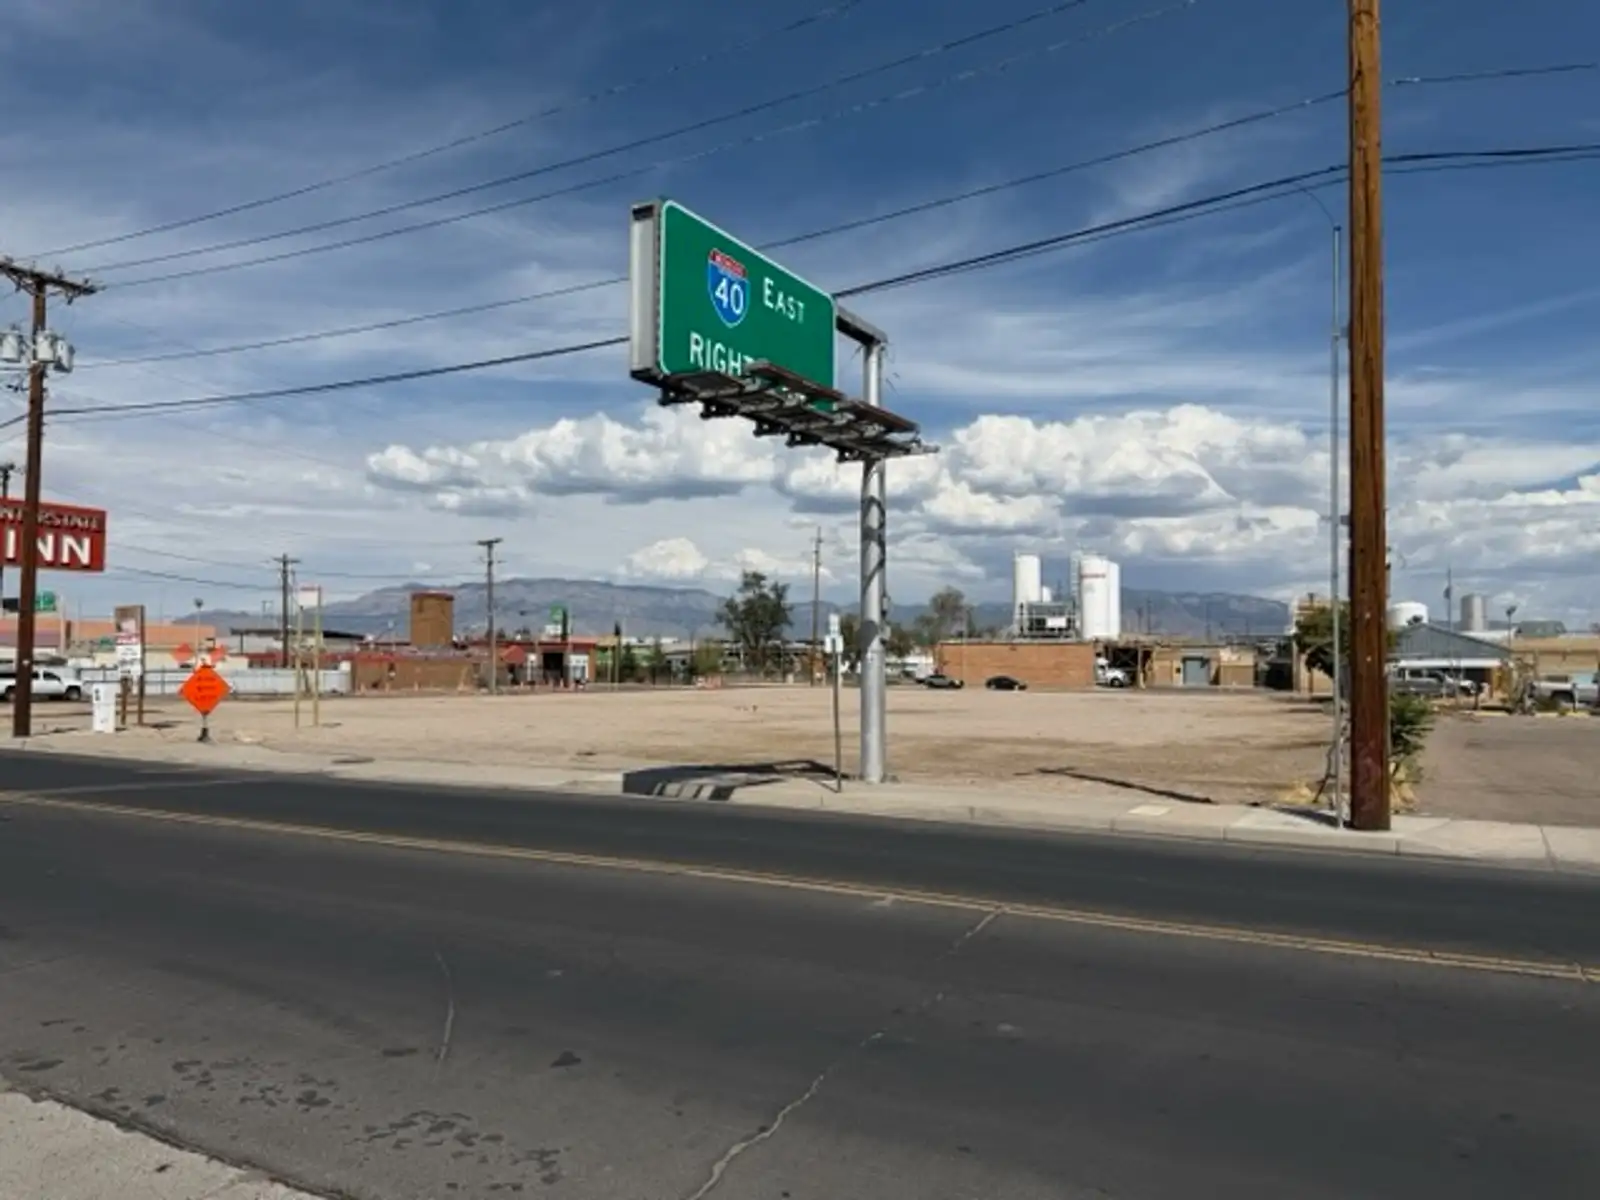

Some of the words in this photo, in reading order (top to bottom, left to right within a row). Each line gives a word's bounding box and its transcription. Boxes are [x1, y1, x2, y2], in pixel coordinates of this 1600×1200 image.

[715, 278, 744, 315] 40
[763, 276, 805, 324] EAST
[7, 529, 91, 565] INN
